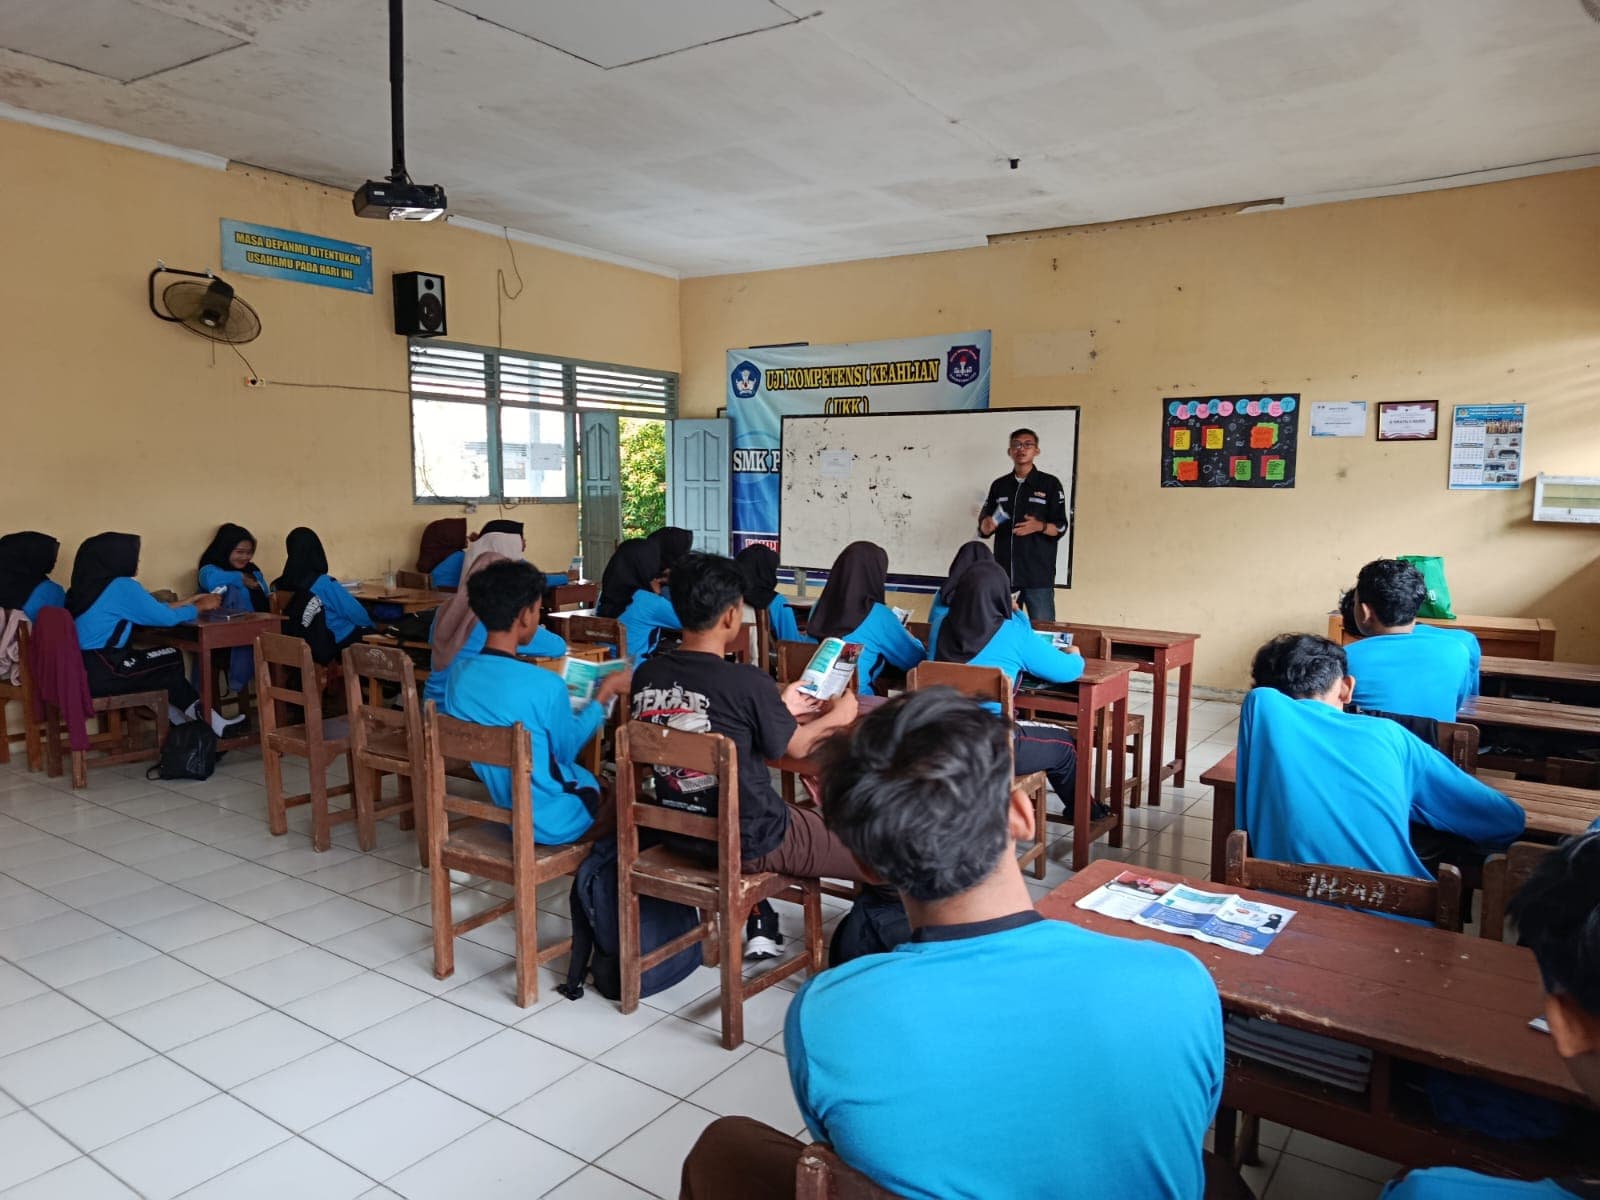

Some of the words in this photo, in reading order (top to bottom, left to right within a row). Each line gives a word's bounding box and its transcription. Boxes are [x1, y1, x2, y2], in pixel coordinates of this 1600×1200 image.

[235, 231, 264, 247] MASA
[265, 238, 309, 255] DEPANMU
[310, 246, 362, 266] DITENTUKAN
[246, 251, 294, 270] USAHAMU
[295, 260, 319, 274] PADA
[320, 264, 340, 278] HARI
[341, 268, 353, 280] INI
[765, 369, 786, 391] UJI
[786, 363, 869, 390] KOMPETENSI
[870, 358, 940, 386] KEAHLIAN
[732, 449, 768, 473] SMK
